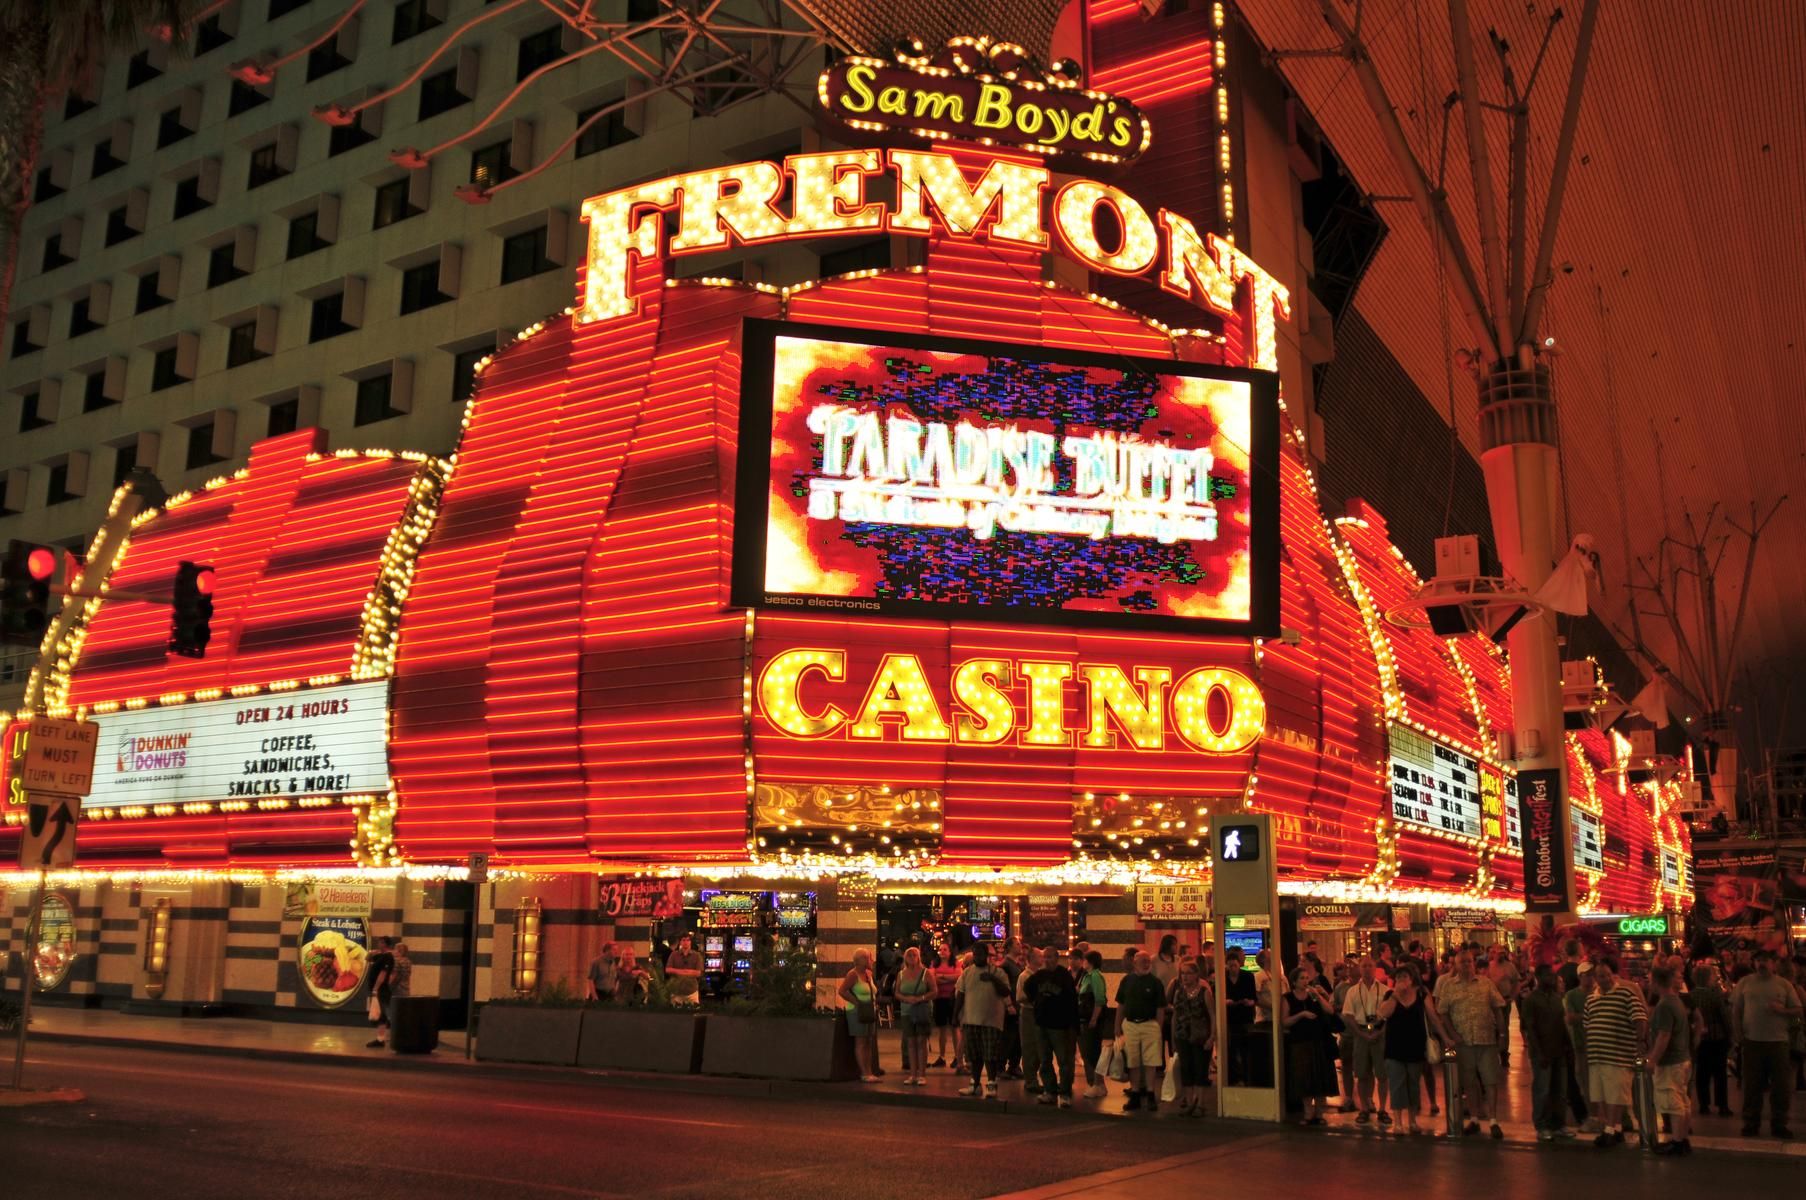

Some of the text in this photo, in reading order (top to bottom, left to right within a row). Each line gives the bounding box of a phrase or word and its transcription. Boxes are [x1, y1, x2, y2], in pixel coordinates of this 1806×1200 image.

[841, 64, 1134, 150] Sam Boyd's
[573, 149, 1290, 372] FREMONT
[807, 405, 1213, 505] PARADISE BUFFET
[765, 596, 880, 610] yesco electronics
[756, 648, 1266, 755] CASINO
[236, 698, 349, 725] OPEN 24 HOURS
[35, 724, 92, 743] LEFT LANE
[137, 732, 191, 753] DUNKIN'
[261, 734, 316, 754] COFFEE,
[42, 746, 79, 764] MUST
[135, 750, 186, 770] DONUTS
[242, 753, 335, 775] SANDWICHES,
[28, 768, 87, 786] TURN LEFT
[228, 774, 350, 796] SNACKS & MORE!
[1142, 903, 1154, 912] $2
[1161, 903, 1174, 912] $3
[1183, 903, 1197, 912] $4
[1305, 905, 1351, 915] GODZILLA
[312, 918, 330, 928] Steak
[1620, 919, 1666, 933] CIGARS
